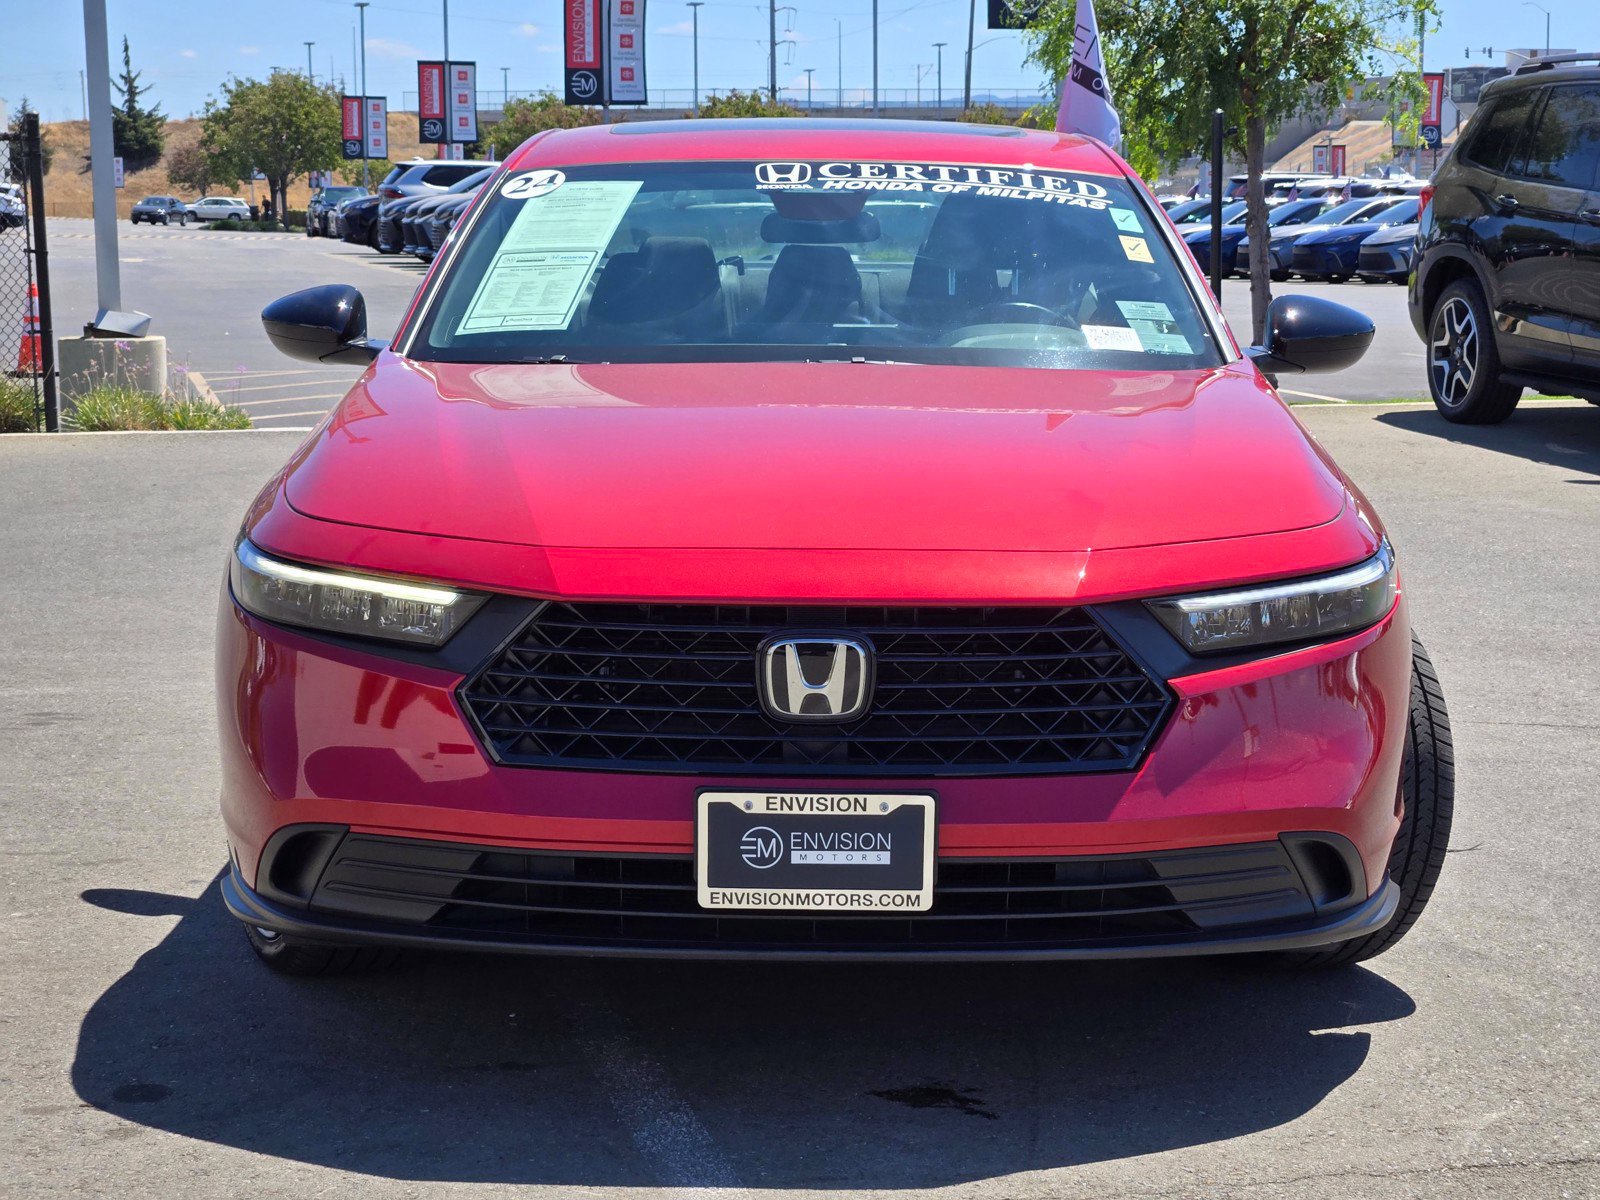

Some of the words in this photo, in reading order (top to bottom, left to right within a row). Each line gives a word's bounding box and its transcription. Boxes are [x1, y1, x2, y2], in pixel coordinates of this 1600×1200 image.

[506, 173, 560, 195] 24
[818, 162, 1108, 198] CERTIFIED
[822, 180, 924, 192] HONDA
[931, 184, 973, 194] OF
[976, 187, 1108, 210] MILPITAS
[765, 796, 867, 812] ENVISION
[790, 832, 891, 850] ENVISION
[799, 853, 882, 862] MOTORS
[709, 891, 921, 908] ENVISIONMOTORS.COM
